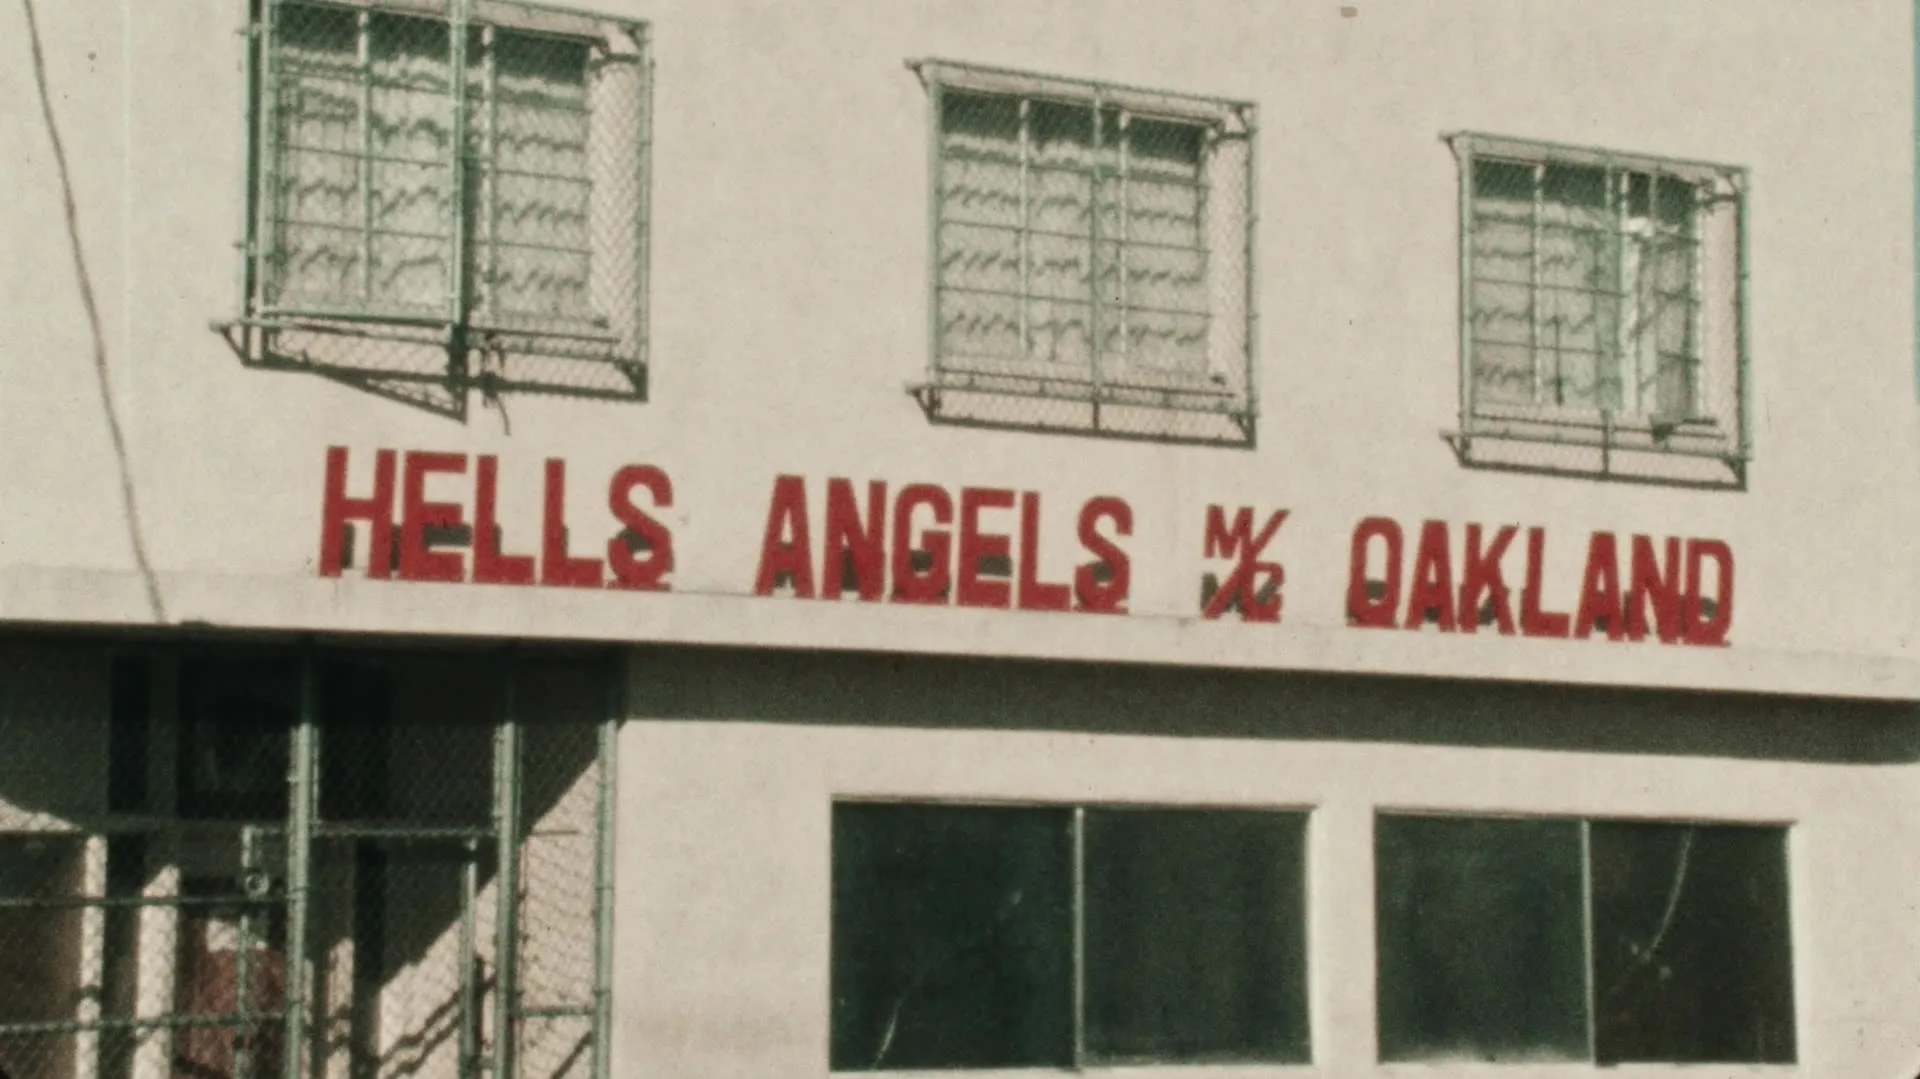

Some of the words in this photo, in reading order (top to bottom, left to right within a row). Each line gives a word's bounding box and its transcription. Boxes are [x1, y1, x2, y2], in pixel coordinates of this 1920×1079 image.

[320, 447, 673, 591] HELLS
[755, 475, 1133, 613] ANGELS
[1347, 516, 1734, 647] OAKLAND
